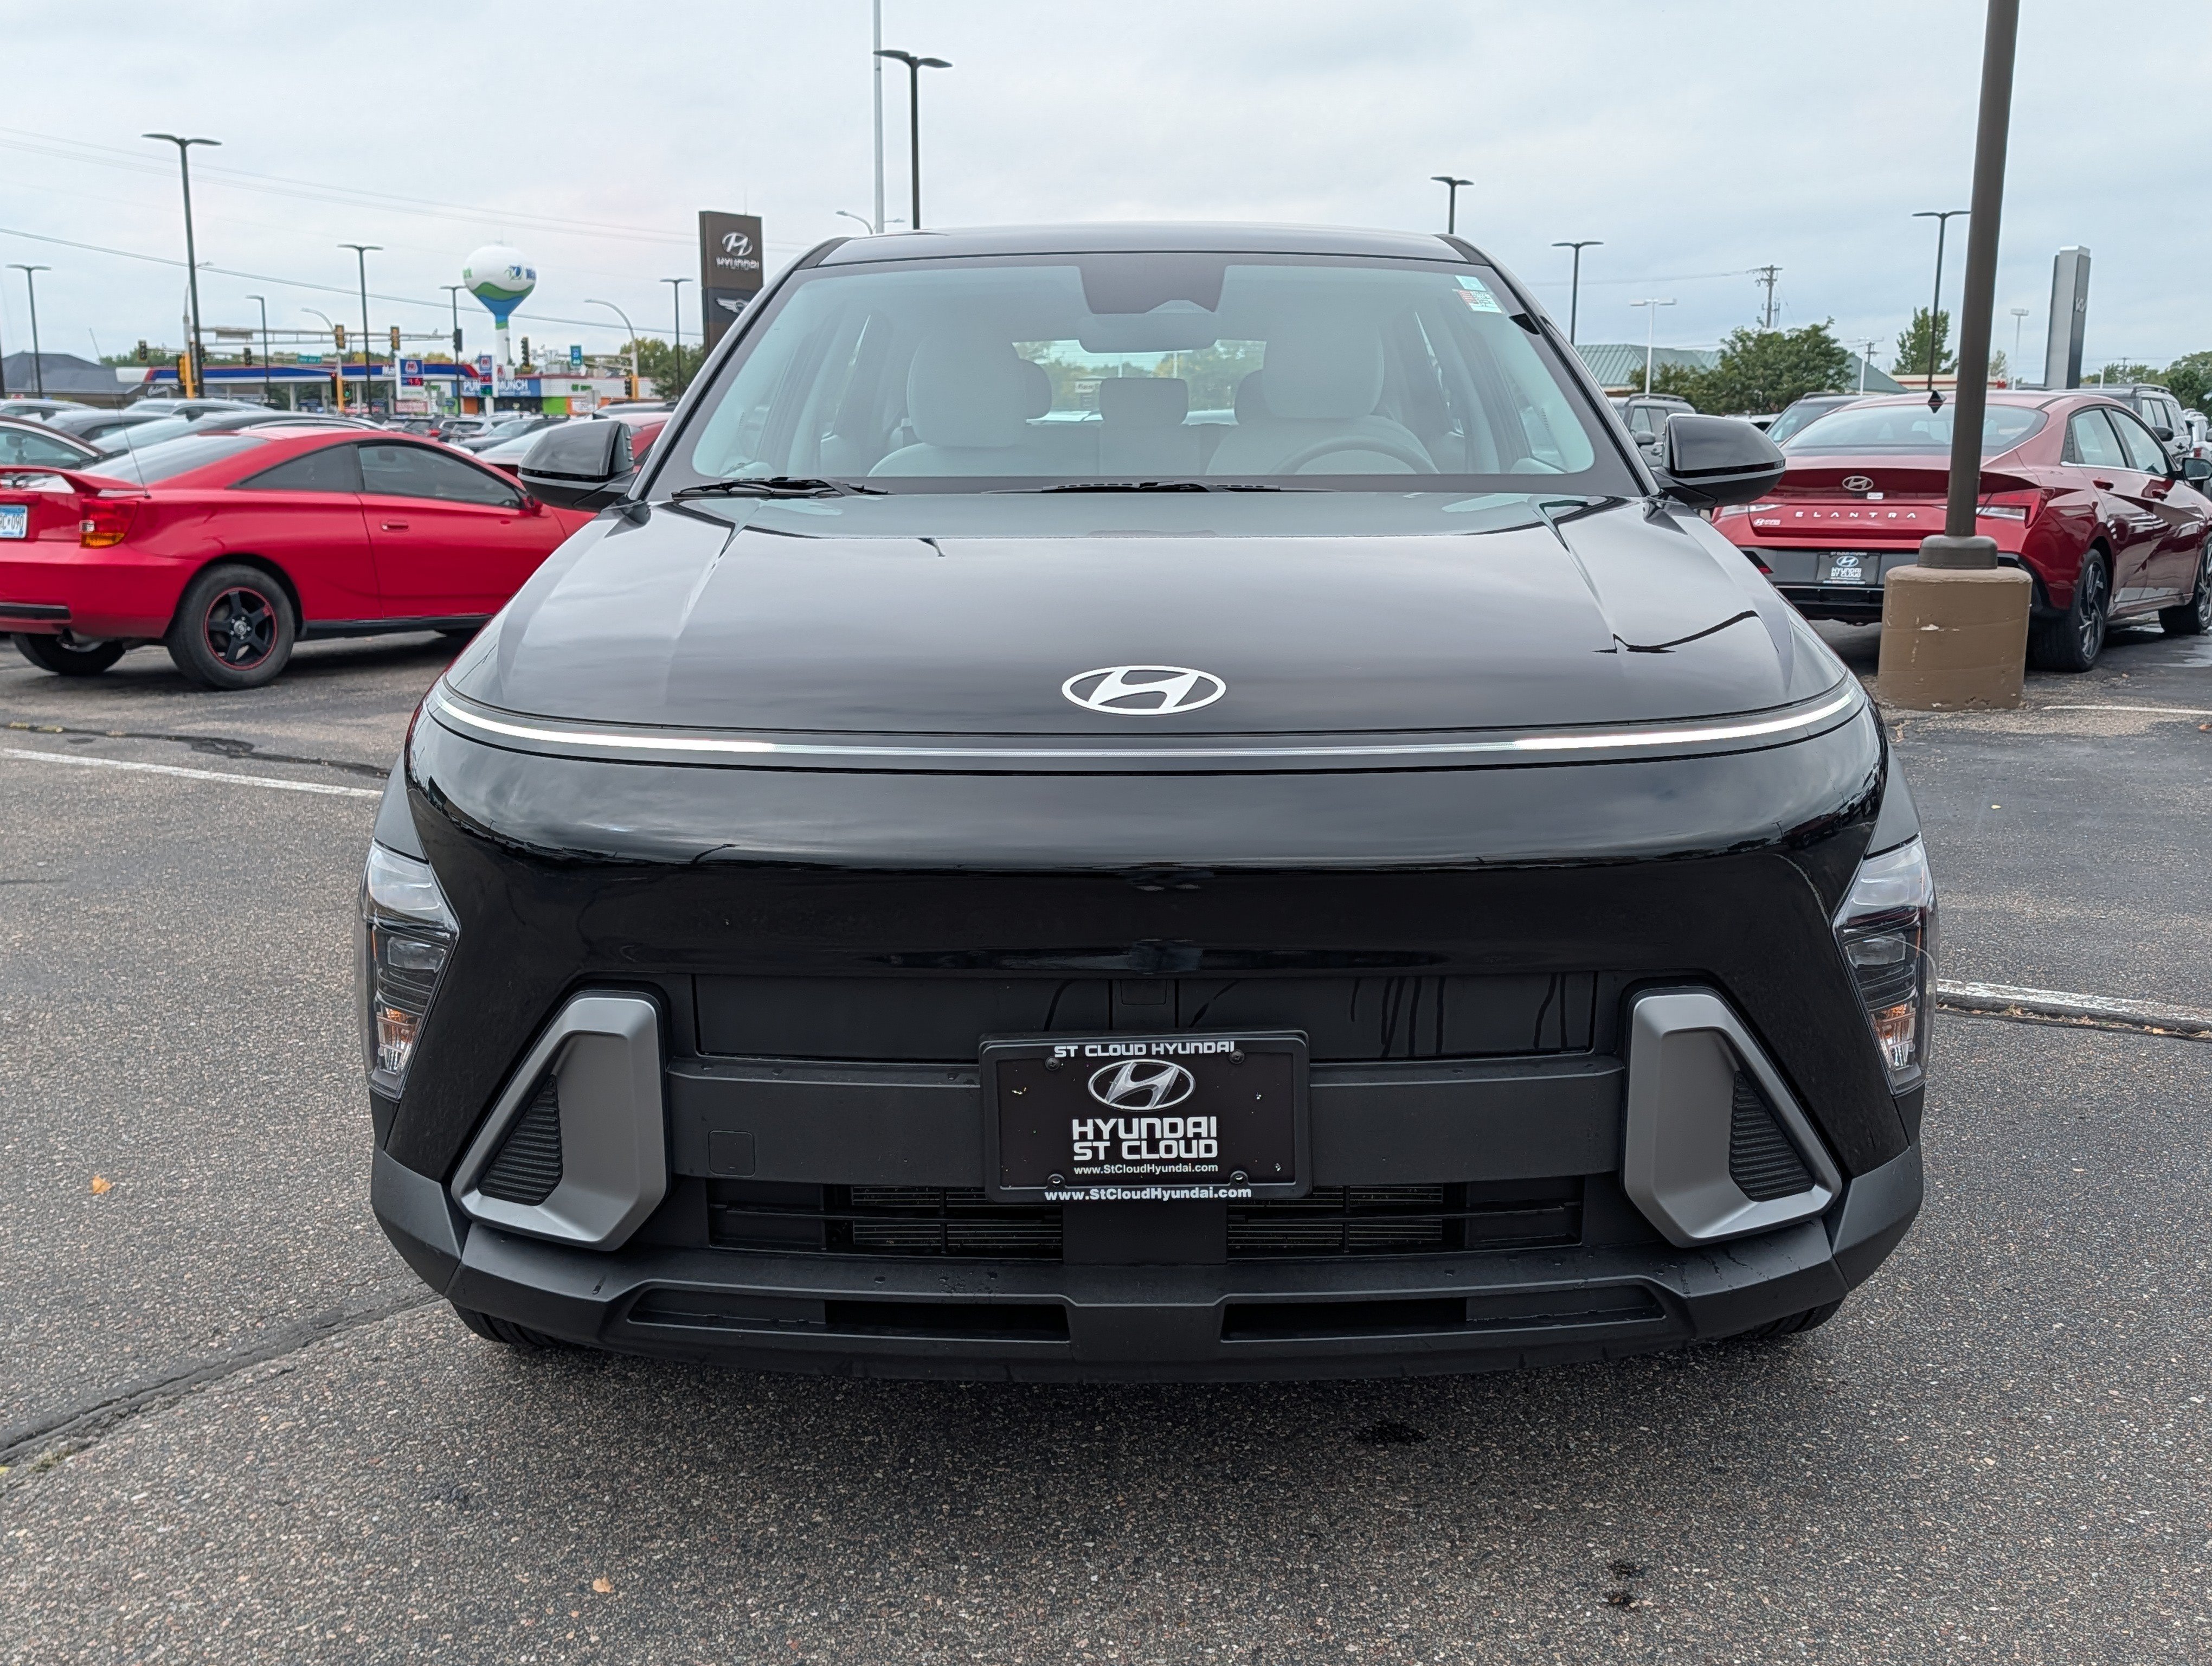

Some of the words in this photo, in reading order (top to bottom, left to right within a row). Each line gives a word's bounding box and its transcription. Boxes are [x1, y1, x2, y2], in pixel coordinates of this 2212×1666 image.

[716, 257, 760, 271] HYUNDAI
[1054, 1045, 1078, 1058] ST
[1085, 1043, 1147, 1057] CLOUD
[1152, 1041, 1234, 1055] HYUNDAI
[1072, 1116, 1217, 1140] HYUNDAI
[1073, 1141, 1110, 1161] ST
[1122, 1139, 1218, 1160] CLOUD
[1073, 1163, 1218, 1175] www.StCloudHyundai.com
[1044, 1187, 1252, 1201] www.StCloudHyundai.com
